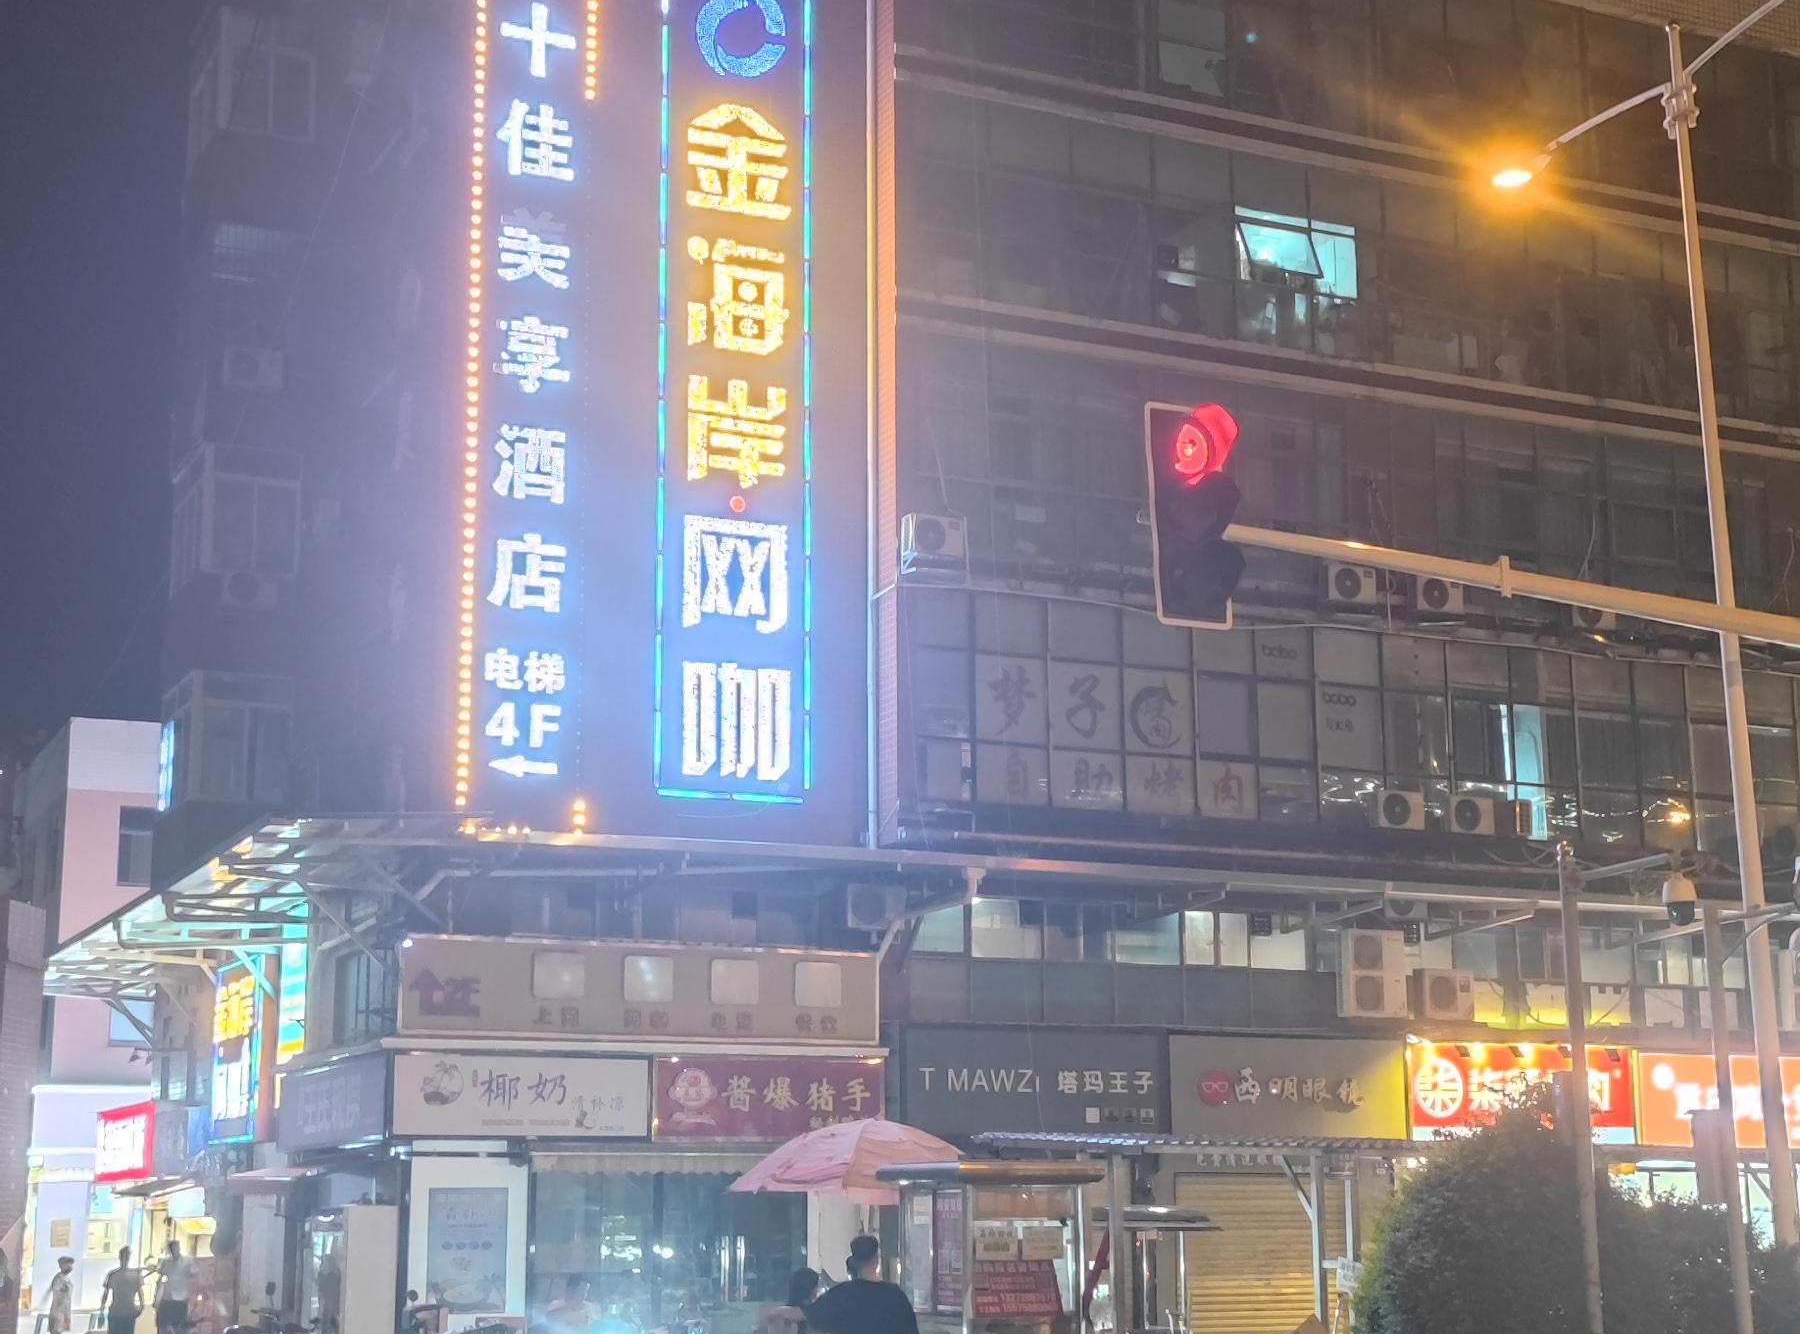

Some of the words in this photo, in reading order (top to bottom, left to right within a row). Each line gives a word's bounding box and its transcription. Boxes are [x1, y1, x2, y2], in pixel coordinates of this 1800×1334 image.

[486, 1, 577, 613] 十佳美享酒店
[484, 647, 565, 694] 电梯
[485, 702, 562, 748] 4F
[1006, 749, 1244, 814] 自助烤肉
[480, 1068, 567, 1112] 椰奶
[721, 1074, 872, 1113] 酱爆猪手
[1057, 1070, 1154, 1095] 塔玛王子
